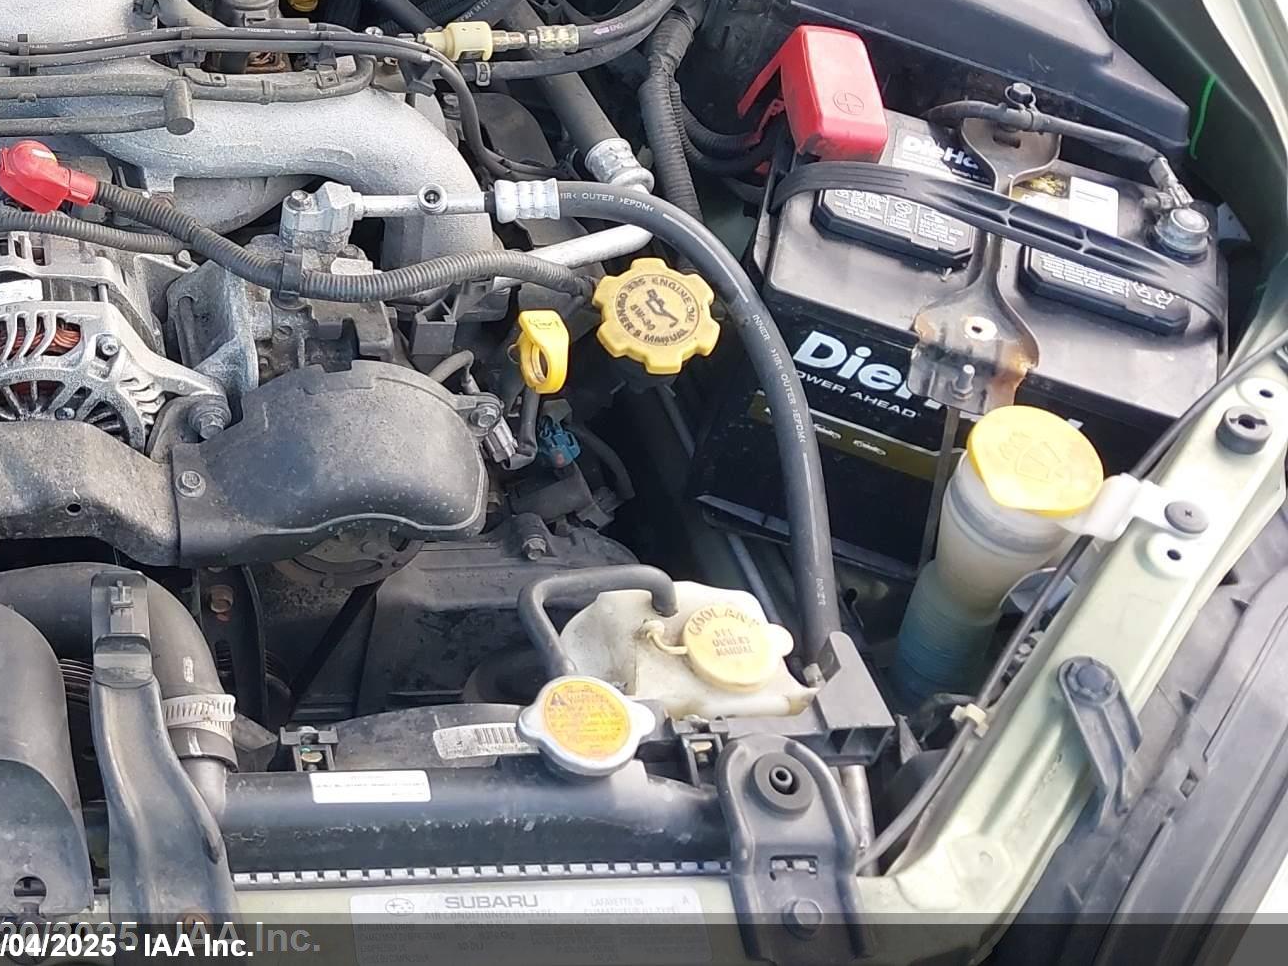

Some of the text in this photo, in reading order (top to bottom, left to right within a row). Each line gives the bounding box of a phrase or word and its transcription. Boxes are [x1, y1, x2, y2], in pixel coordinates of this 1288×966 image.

[582, 192, 615, 202] OUTER
[651, 276, 692, 305] ENGINE
[779, 373, 798, 411] OUTER
[850, 391, 917, 418] AHEAD
[445, 894, 538, 909] SUBARU
